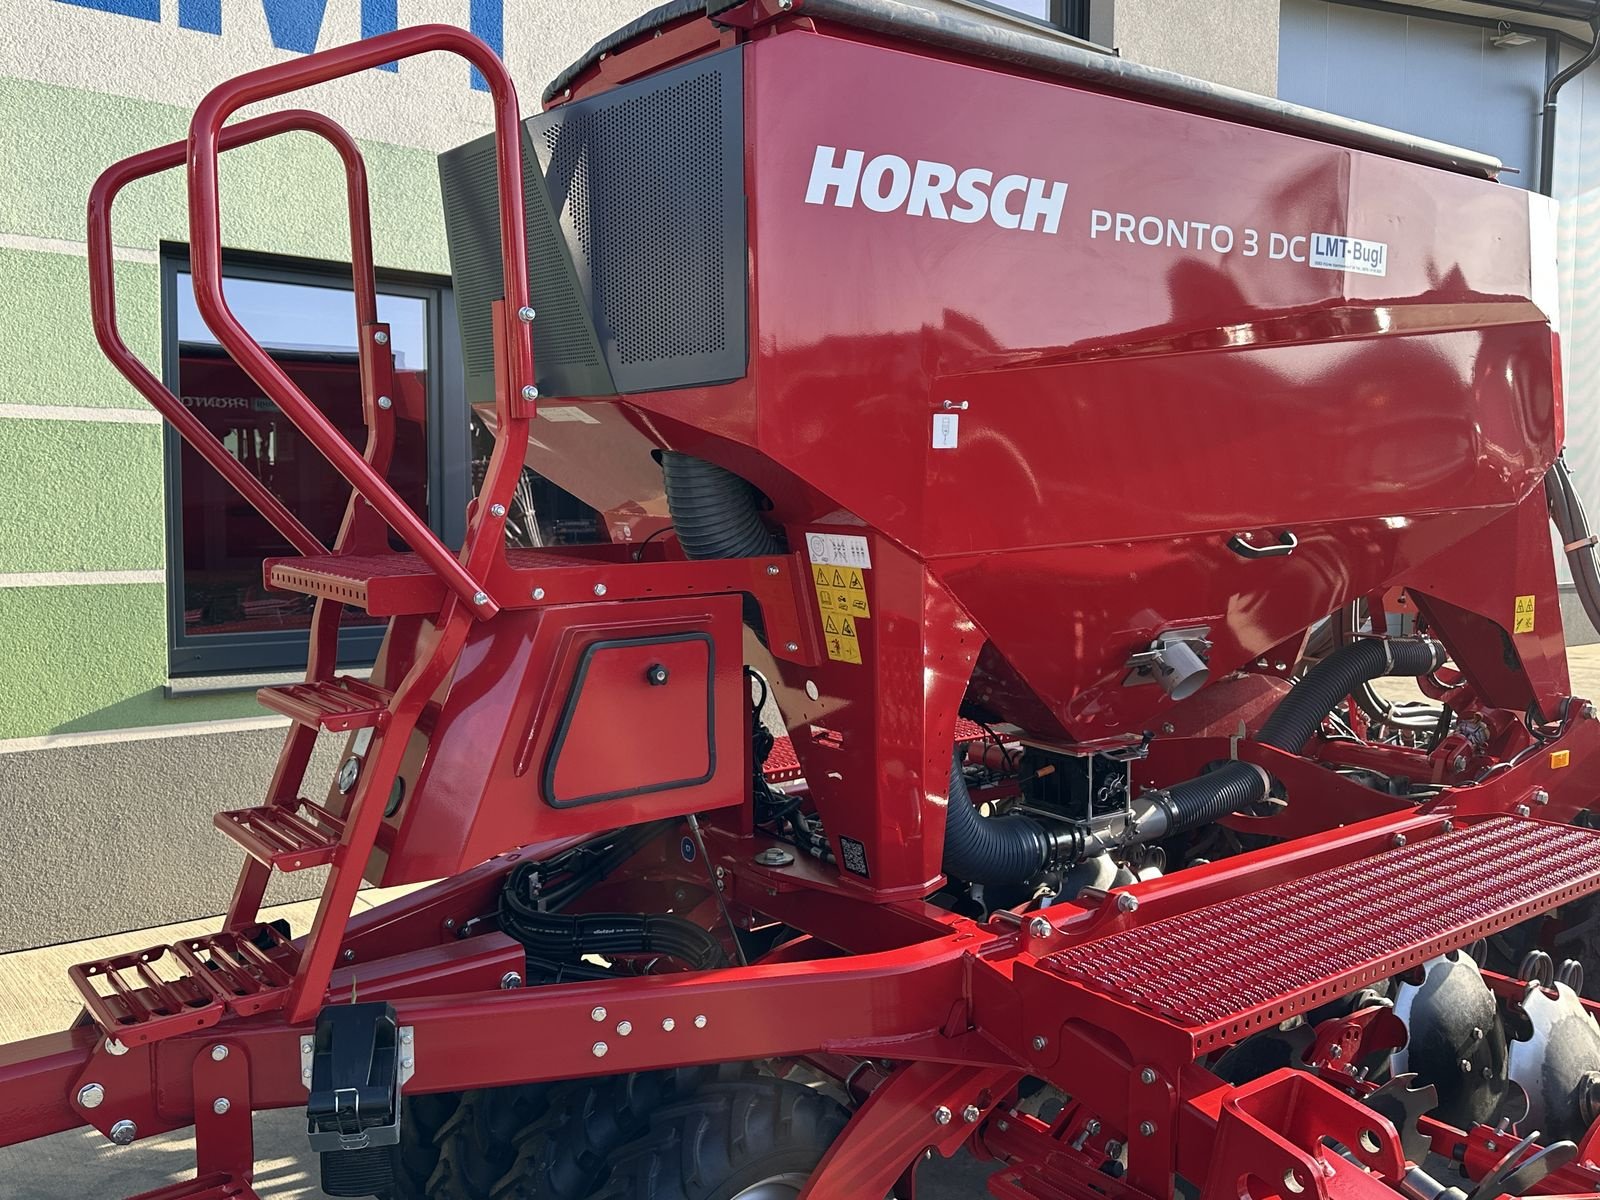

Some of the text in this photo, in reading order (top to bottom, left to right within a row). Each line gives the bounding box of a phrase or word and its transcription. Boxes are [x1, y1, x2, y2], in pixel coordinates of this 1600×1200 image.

[804, 145, 1069, 234] HORSCH
[1090, 209, 1306, 262] PRONTO 3 DC
[1315, 236, 1383, 268] LMT-Bugl
